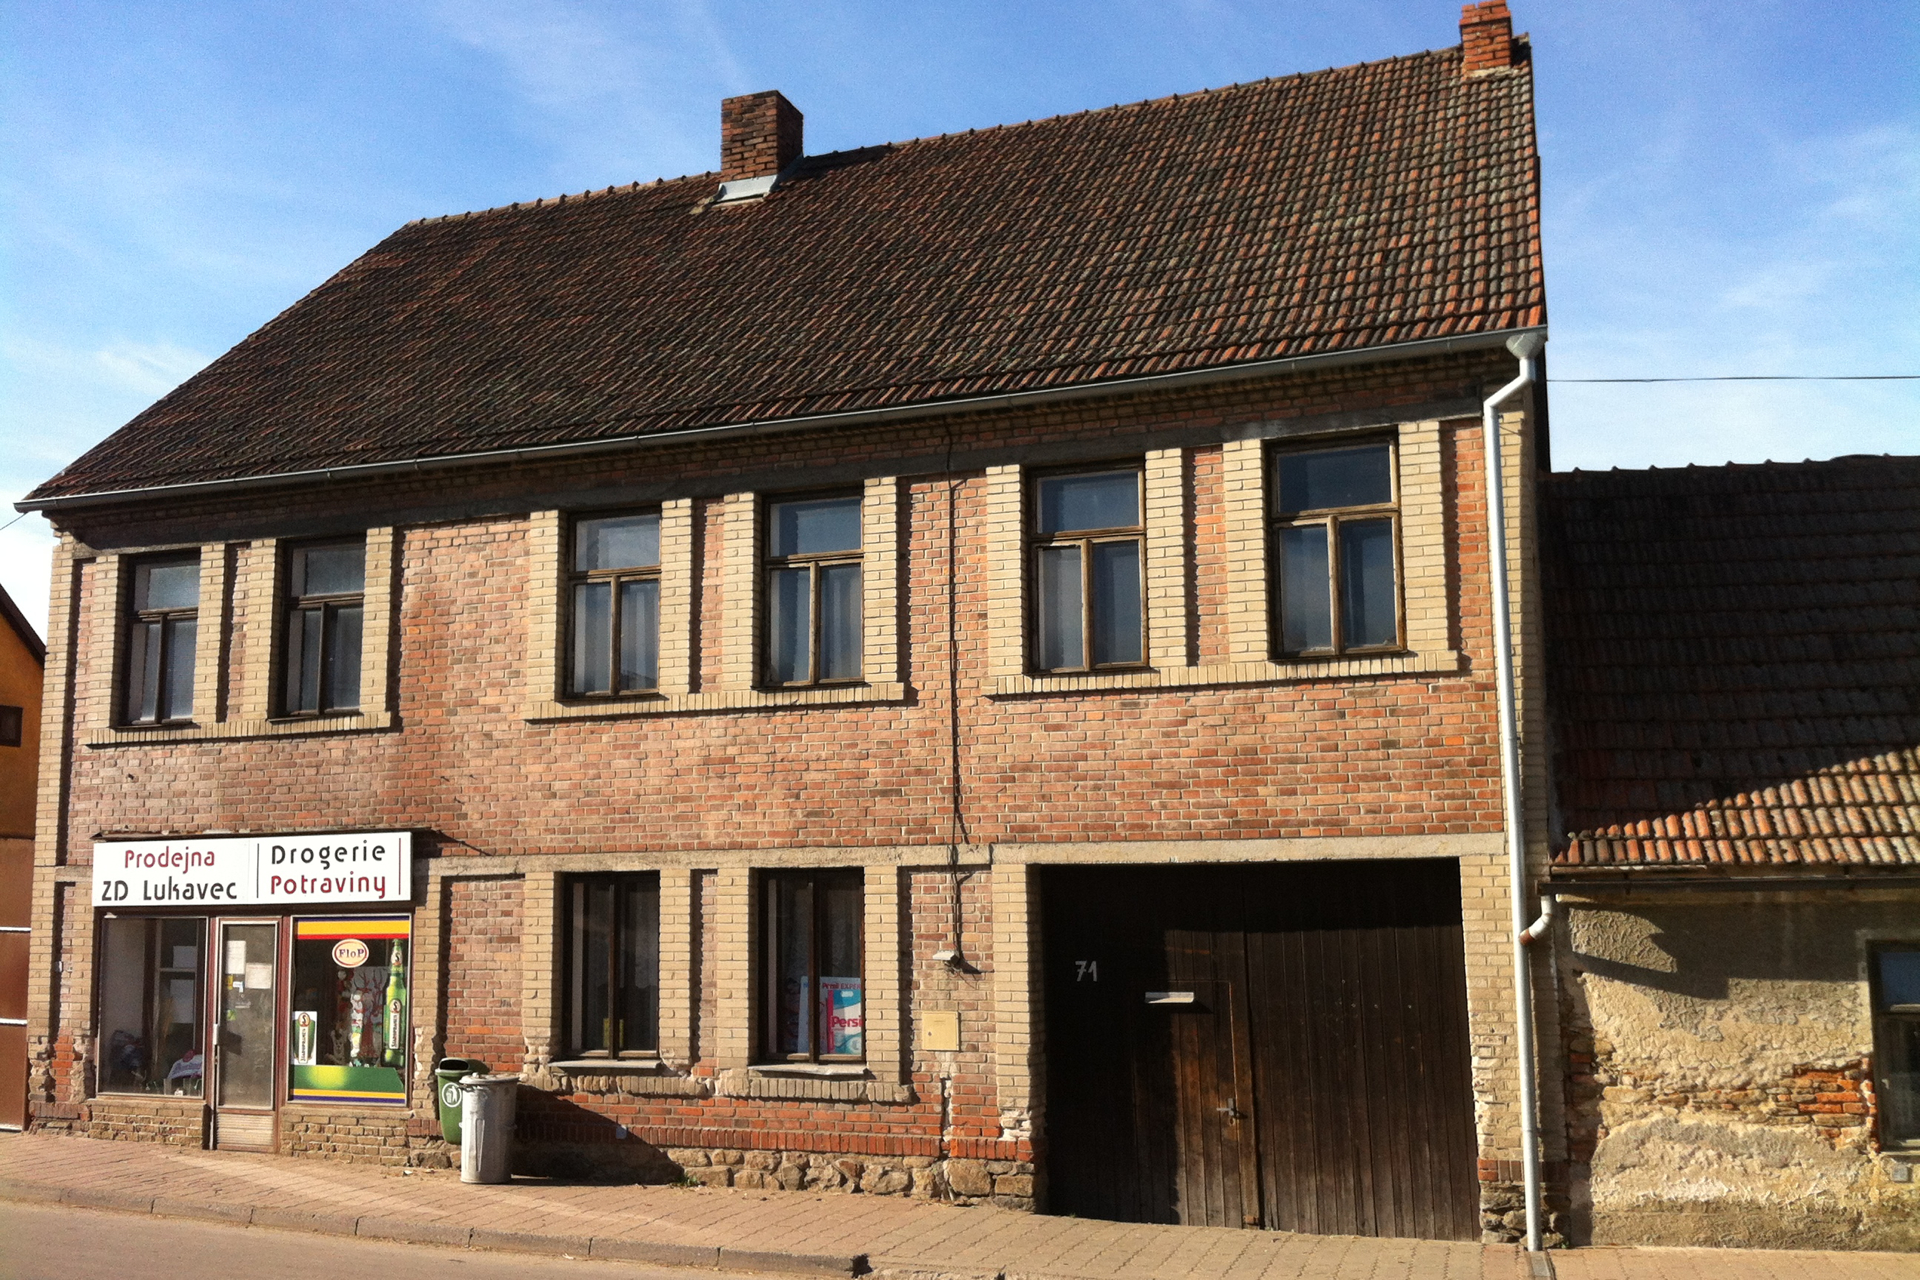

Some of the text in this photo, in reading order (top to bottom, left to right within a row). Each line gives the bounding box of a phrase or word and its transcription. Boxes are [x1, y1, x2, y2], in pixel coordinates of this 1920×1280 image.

[124, 846, 215, 874] Prodejna
[271, 840, 386, 870] Drogerie
[101, 876, 238, 901] ZD Lukavec
[270, 871, 386, 899] Potraviny
[338, 948, 365, 959] FloP
[1074, 960, 1098, 982] 71
